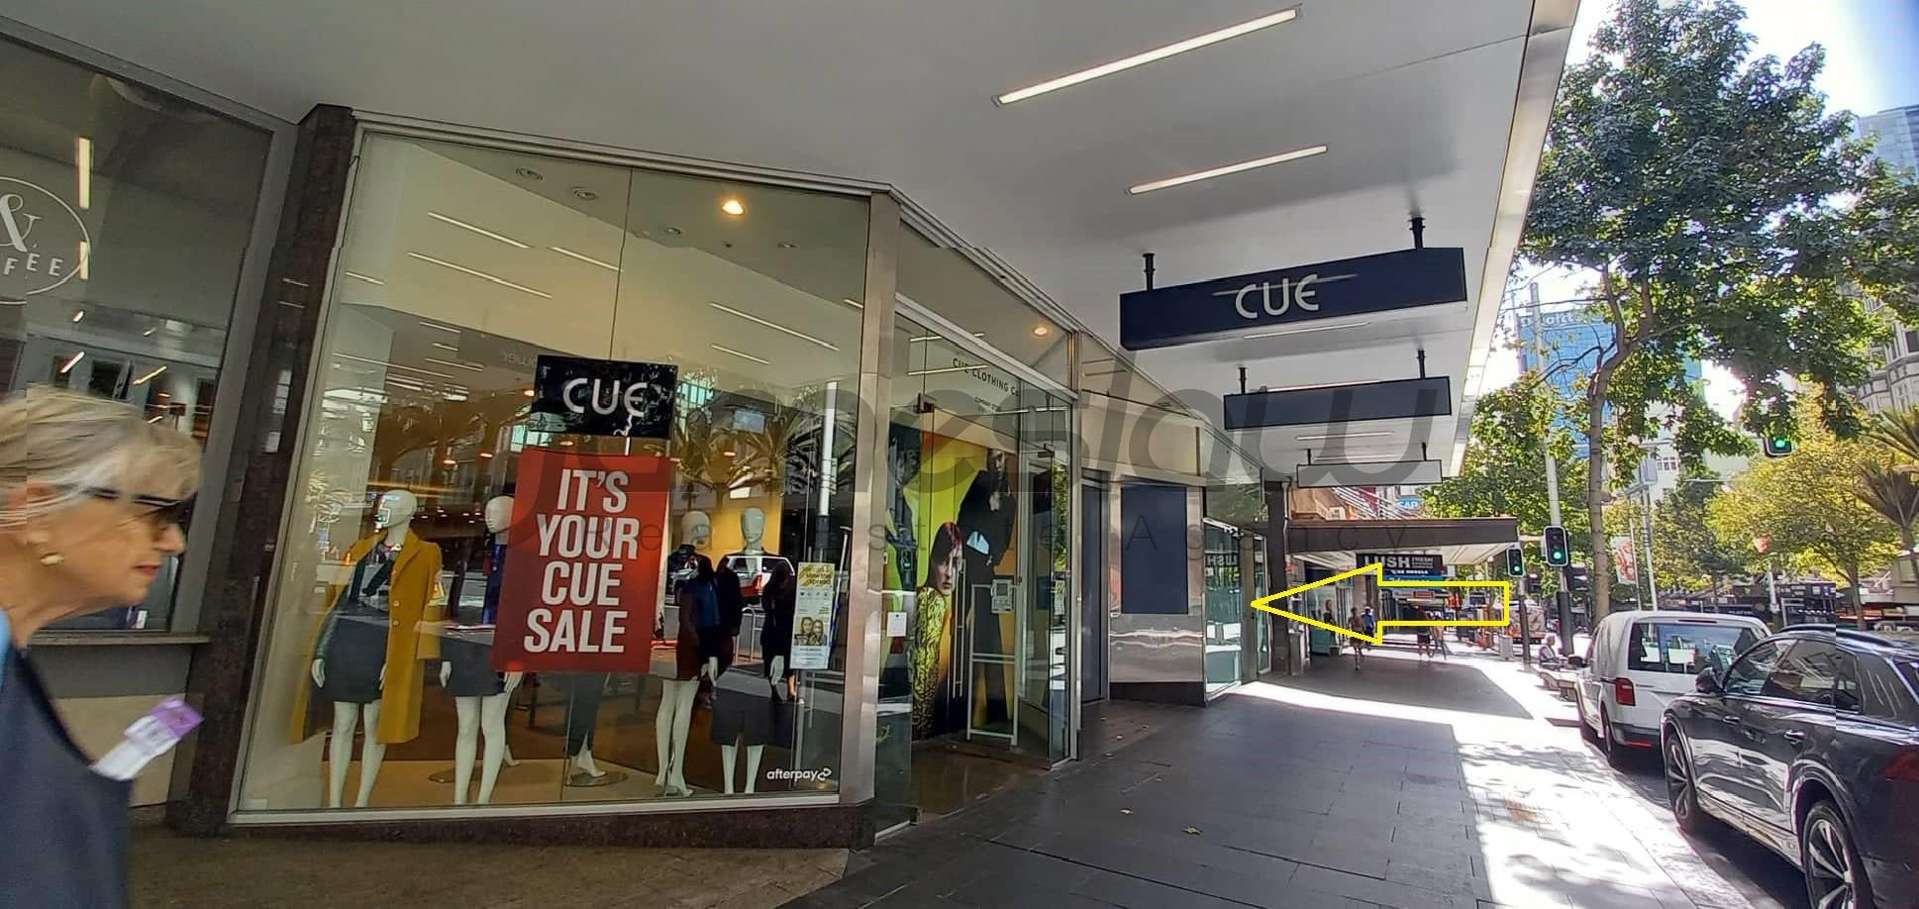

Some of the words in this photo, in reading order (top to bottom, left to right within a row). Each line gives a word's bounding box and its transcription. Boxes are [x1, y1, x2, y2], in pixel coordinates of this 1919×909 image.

[1235, 274, 1319, 319] CUE
[563, 378, 648, 417] CUE
[952, 358, 969, 373] CUE
[972, 367, 1009, 392] CLOTHING
[537, 514, 640, 560] YOUR
[541, 561, 623, 606] CUE
[523, 608, 628, 653] SALE
[767, 769, 818, 782] afterpay
